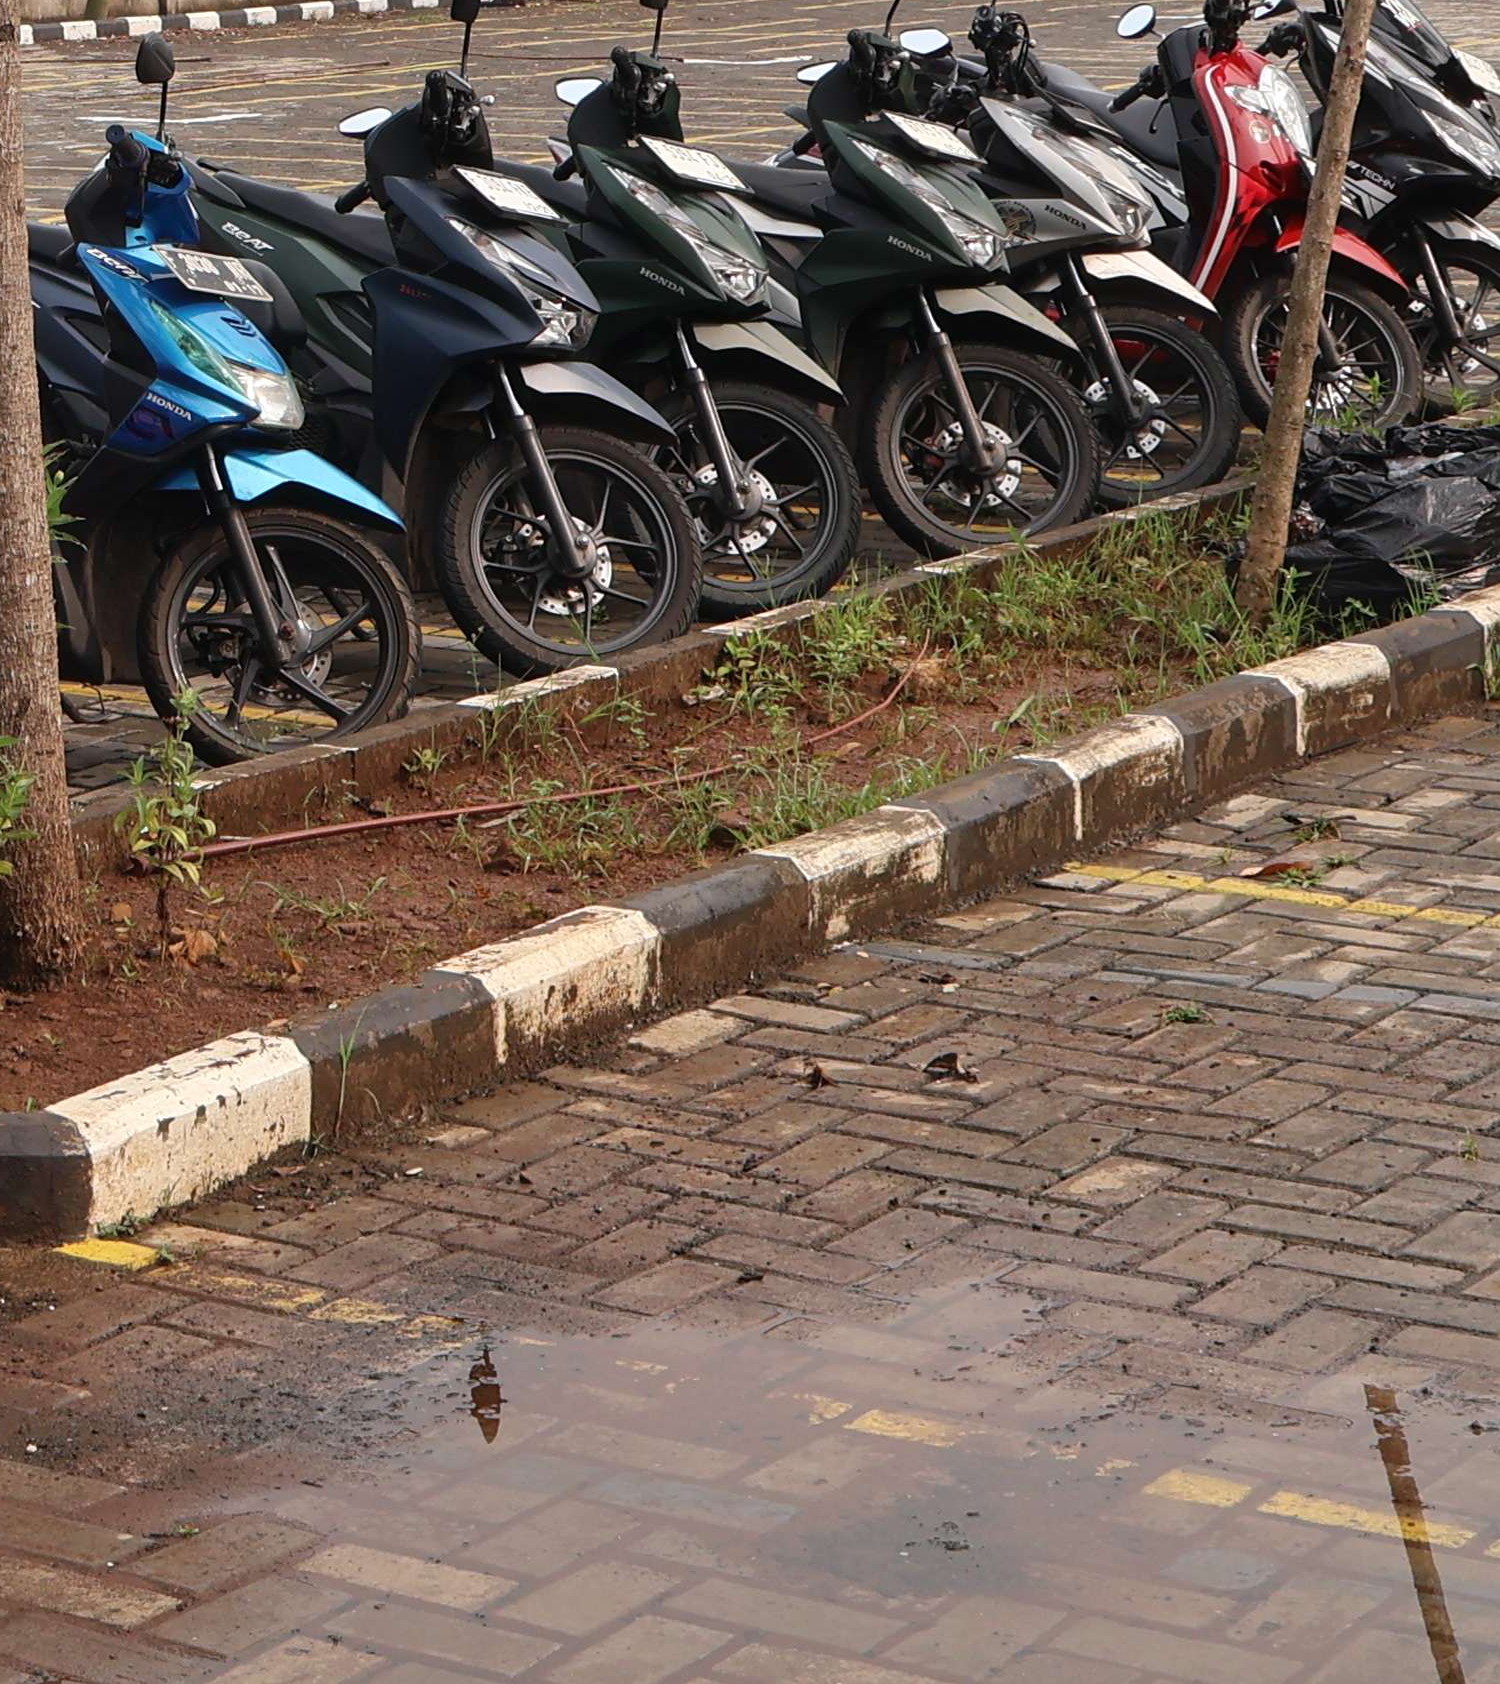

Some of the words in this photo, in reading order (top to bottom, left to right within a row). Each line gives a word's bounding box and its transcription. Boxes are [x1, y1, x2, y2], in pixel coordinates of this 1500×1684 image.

[1044, 204, 1088, 231] HONDA
[887, 234, 932, 262] HONDA
[639, 266, 686, 296] HONDA
[146, 392, 192, 421] HONDA
